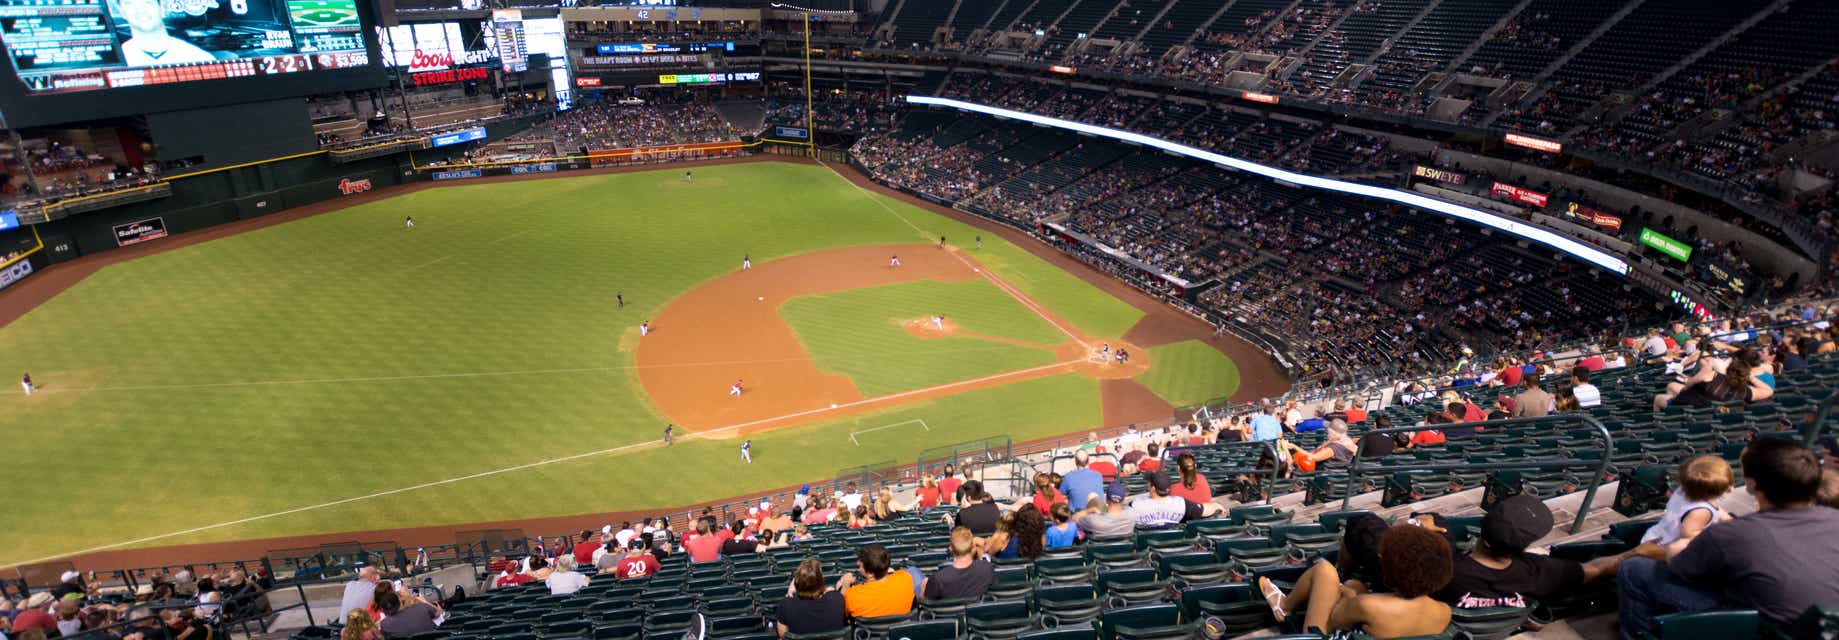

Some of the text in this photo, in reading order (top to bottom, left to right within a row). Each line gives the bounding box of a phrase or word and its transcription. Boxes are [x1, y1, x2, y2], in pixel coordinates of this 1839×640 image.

[638, 10, 648, 19] 42
[264, 57, 279, 74] 2
[283, 55, 298, 71] 2
[410, 48, 454, 69] Coors
[413, 67, 488, 86] STRIKE ZONE
[1424, 168, 1462, 184] SWEYE
[118, 225, 153, 237] Safelite
[55, 244, 69, 252] 413
[627, 561, 646, 575] 20
